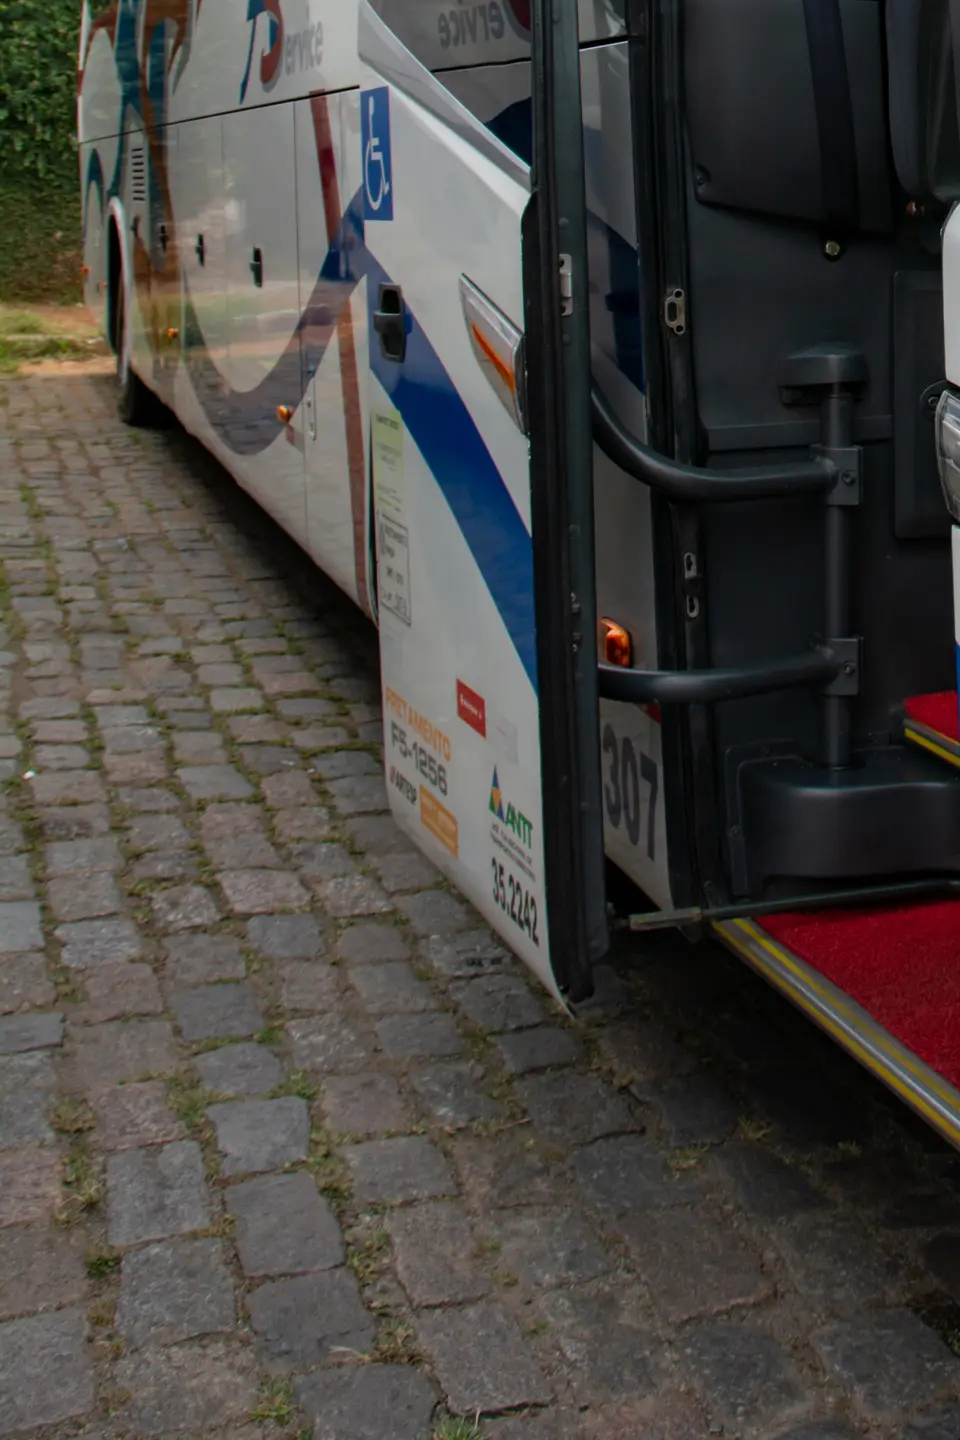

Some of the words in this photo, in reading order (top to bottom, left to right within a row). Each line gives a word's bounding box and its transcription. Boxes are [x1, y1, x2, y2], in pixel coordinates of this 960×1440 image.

[505, 800, 533, 849] ANTT
[602, 723, 658, 862] 307
[491, 856, 540, 948] 35.2242
